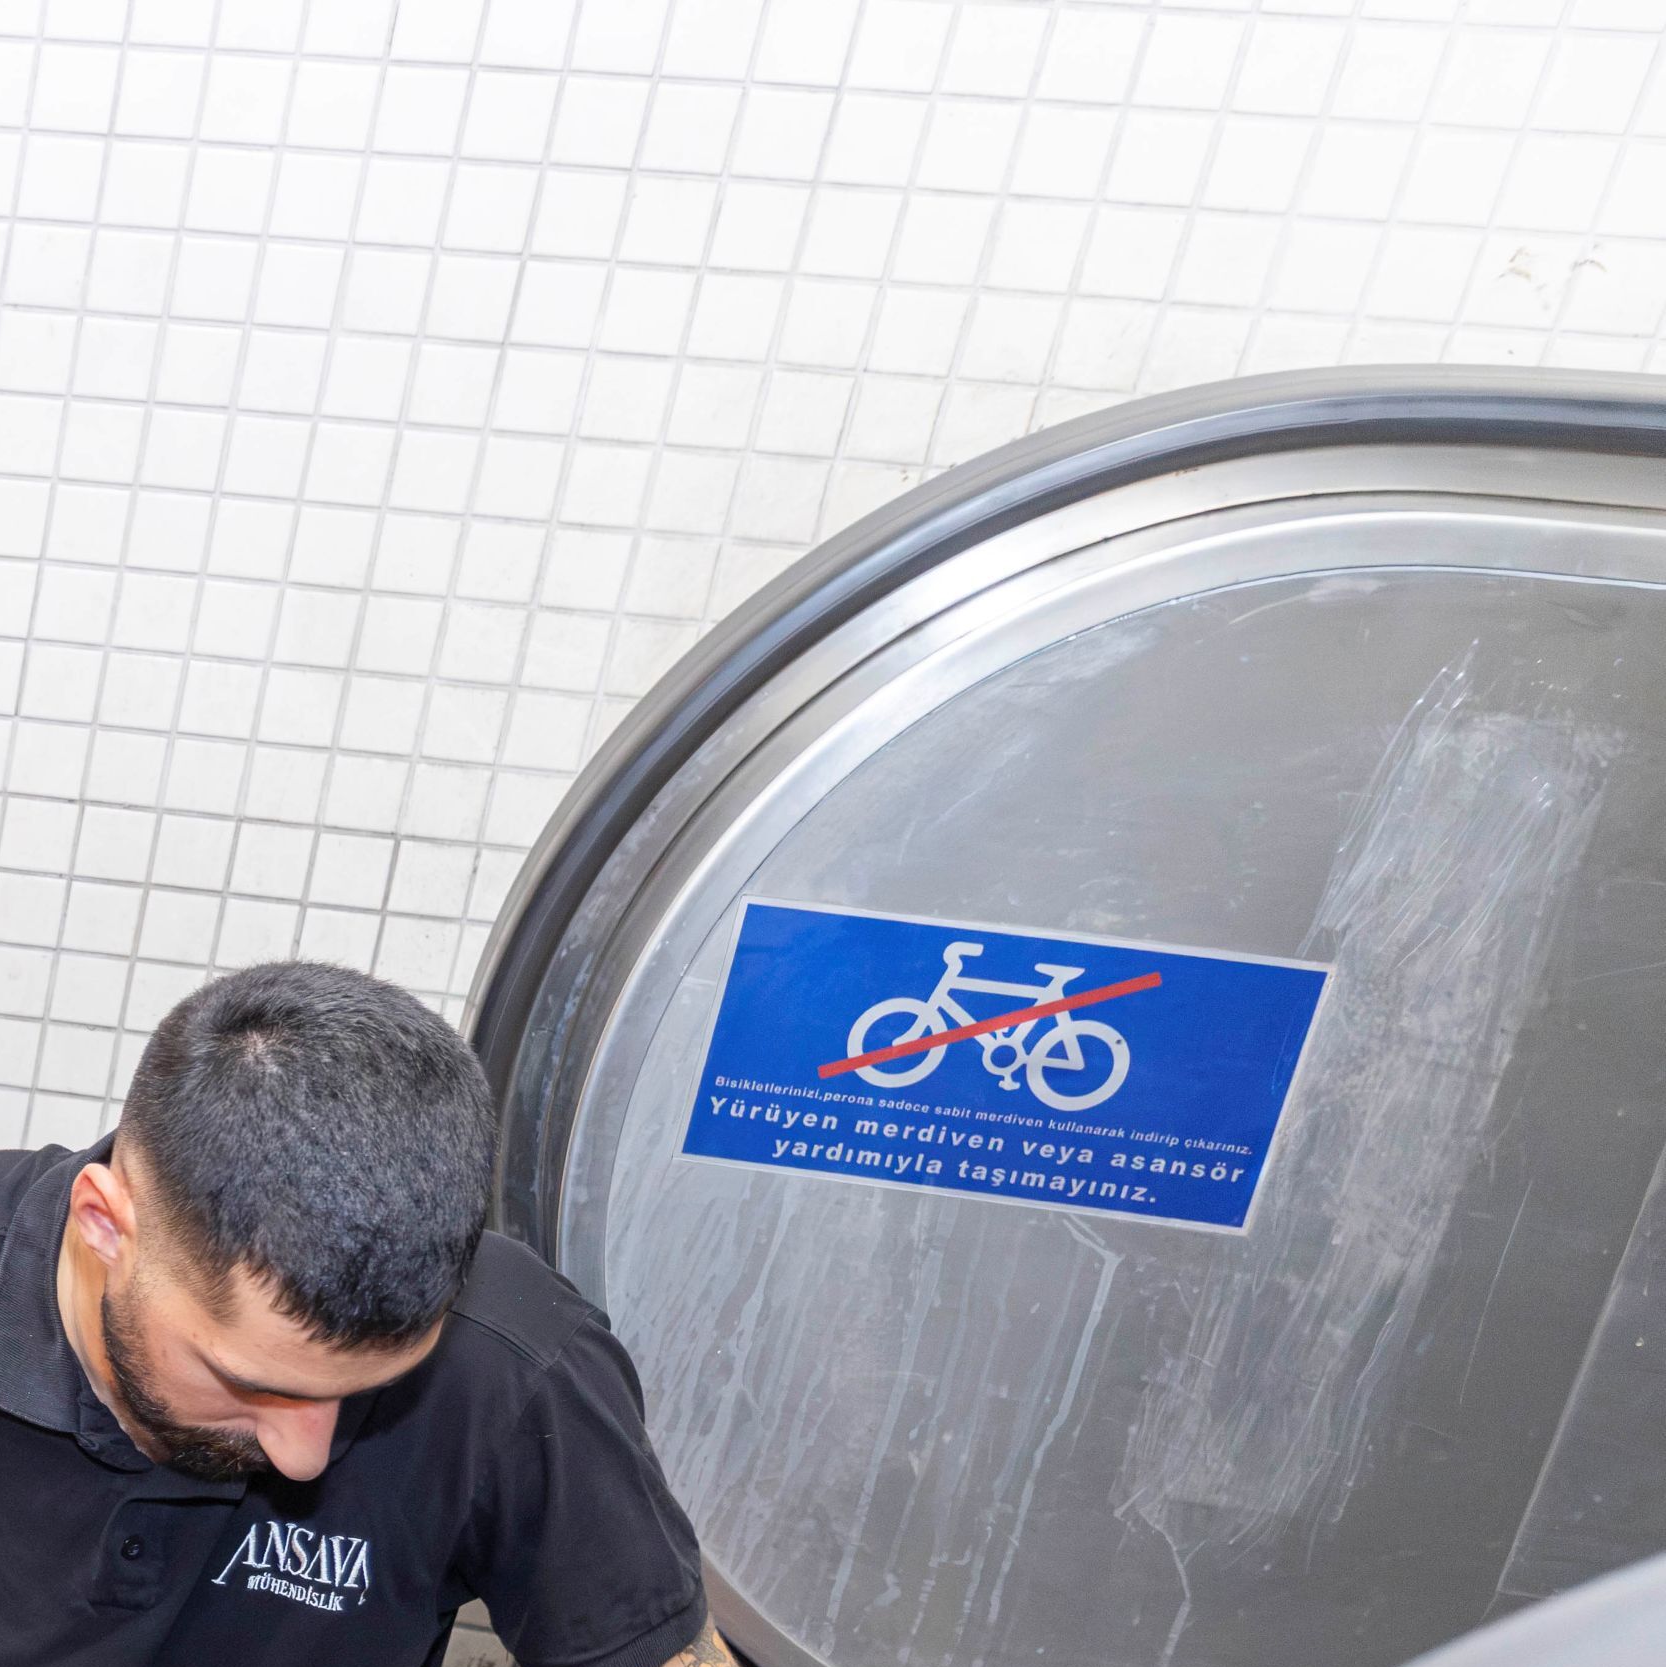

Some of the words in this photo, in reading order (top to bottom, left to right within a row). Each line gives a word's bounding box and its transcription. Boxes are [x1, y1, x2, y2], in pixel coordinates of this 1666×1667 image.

[709, 1096, 839, 1131] Yürüyen
[854, 1118, 1005, 1152] merdiven
[1023, 1139, 1095, 1165] veya
[1110, 1151, 1245, 1183] asansör
[878, 1097, 931, 1114] sadece
[934, 1105, 971, 1119] sabit
[975, 1111, 1044, 1128] merdiven
[1048, 1119, 1126, 1139] kullanarak
[1130, 1129, 1180, 1147] indirip
[1184, 1136, 1254, 1156] çıkarınız.
[772, 1139, 943, 1175] yardımıyla
[958, 1160, 1156, 1203] taşımayınız.
[247, 1572, 344, 1611] MÜHENDİSLİK
